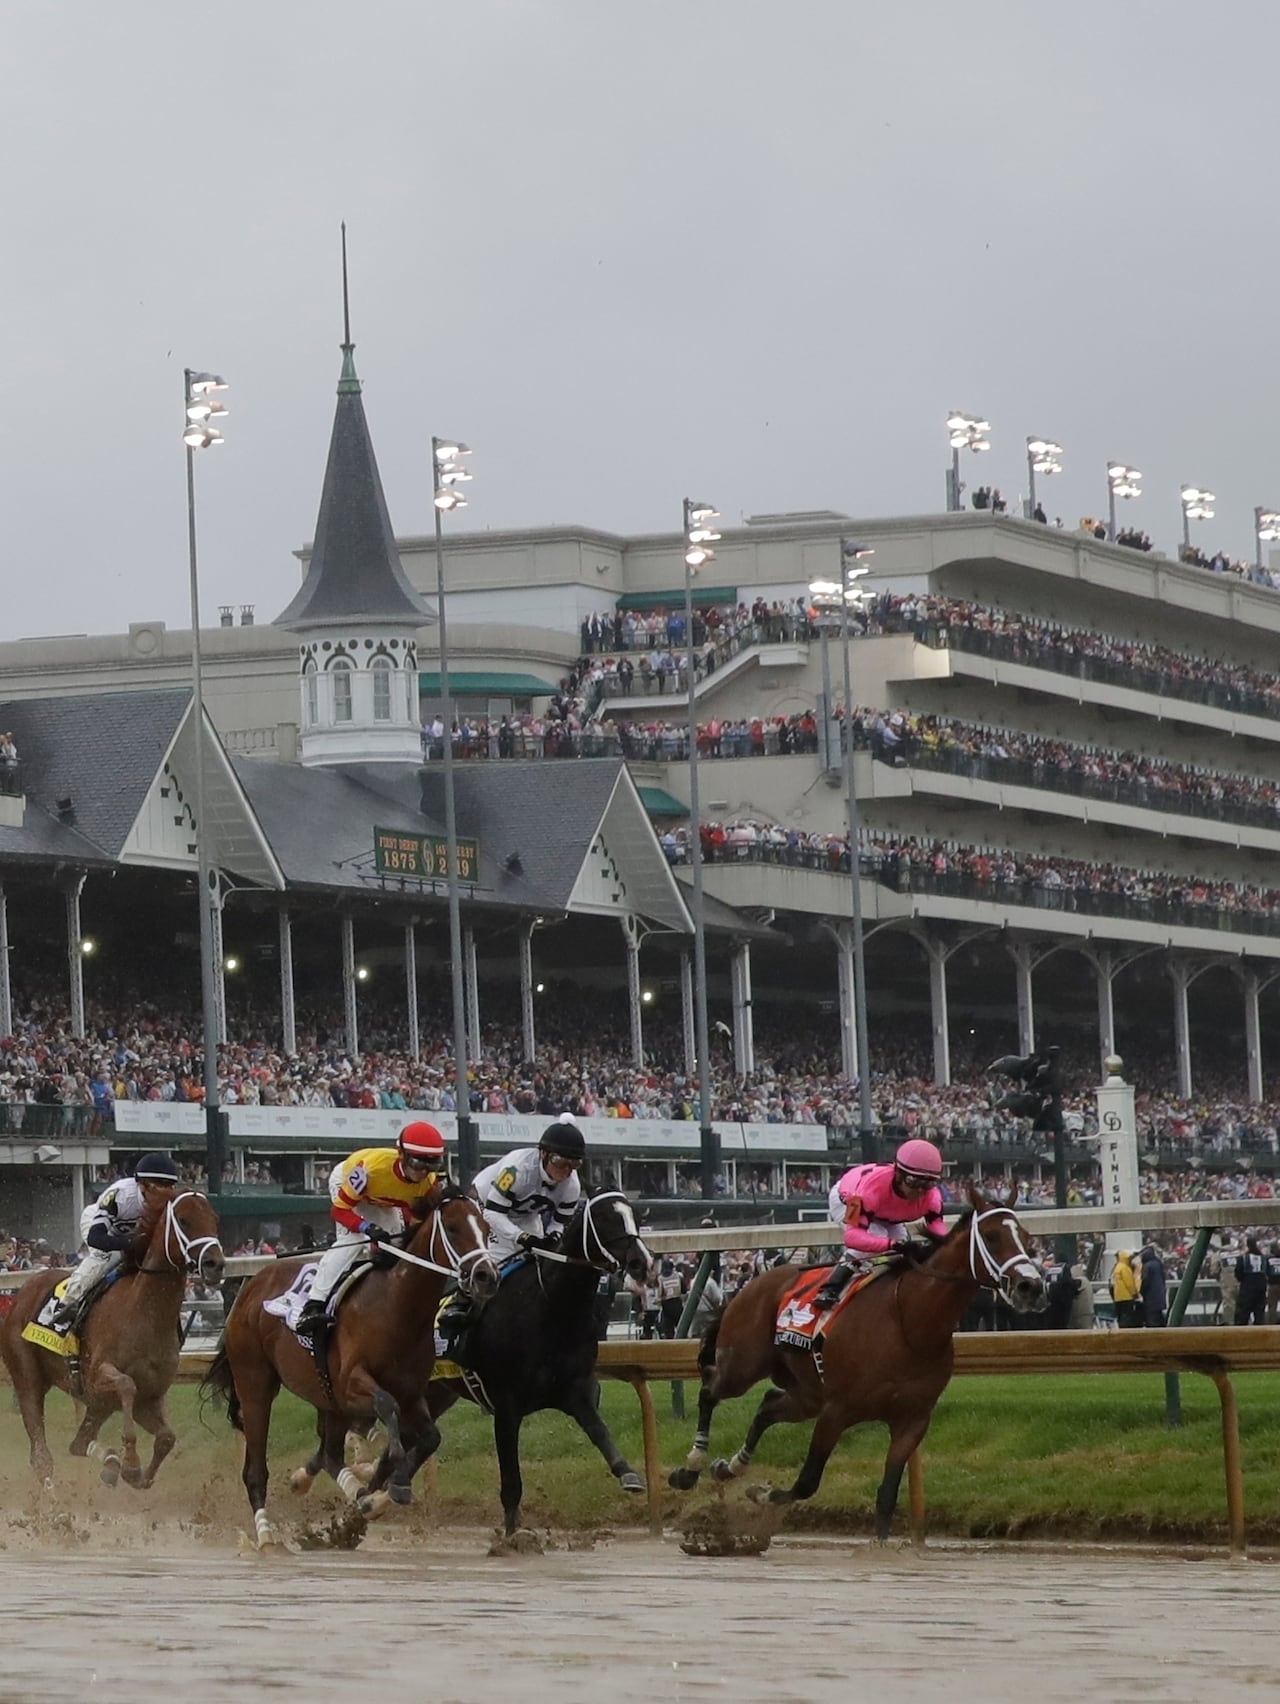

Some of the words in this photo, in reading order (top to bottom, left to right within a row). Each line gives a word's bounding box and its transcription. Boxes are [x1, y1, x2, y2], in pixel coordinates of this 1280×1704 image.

[383, 850, 416, 871] 1875
[439, 856, 470, 877] 219
[349, 1170, 364, 1191] 21
[496, 1168, 514, 1192] 18
[1110, 1142, 1121, 1204] FINISH
